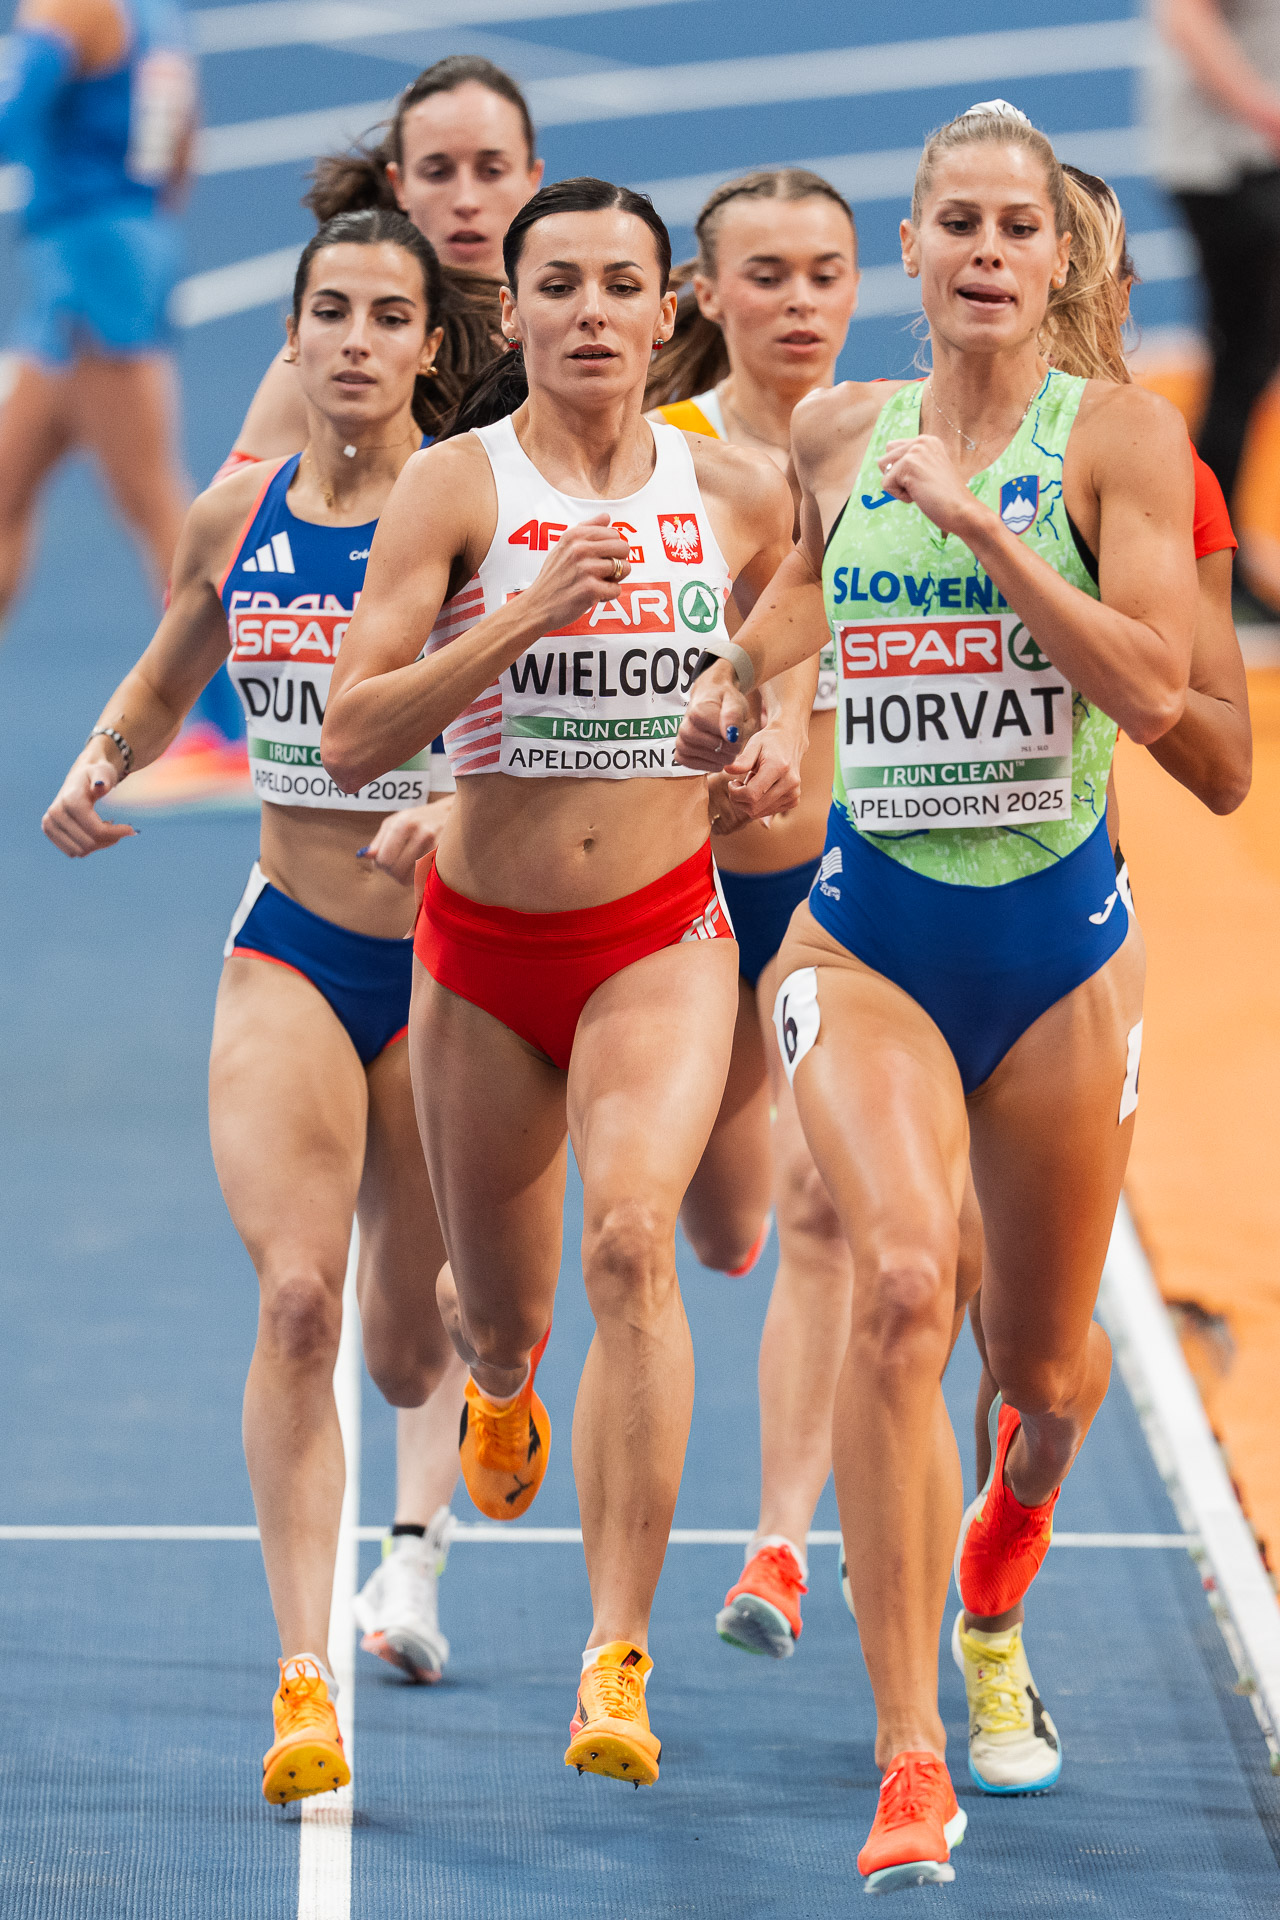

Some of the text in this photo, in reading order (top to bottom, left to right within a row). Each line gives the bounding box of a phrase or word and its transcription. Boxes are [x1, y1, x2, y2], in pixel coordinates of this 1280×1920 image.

[508, 519, 568, 551] 4F
[584, 589, 670, 628] AR
[844, 628, 998, 671] SPAR
[845, 686, 1064, 745] HORVAT
[552, 720, 558, 737] I
[563, 721, 610, 739] RUN
[269, 743, 274, 759] I
[274, 744, 307, 764] RUN
[508, 748, 665, 770] APELDOORN
[254, 769, 422, 800] APELDOOR 2025
[882, 767, 889, 785] I
[893, 766, 936, 785] RUN
[1007, 789, 1064, 812] 2025
